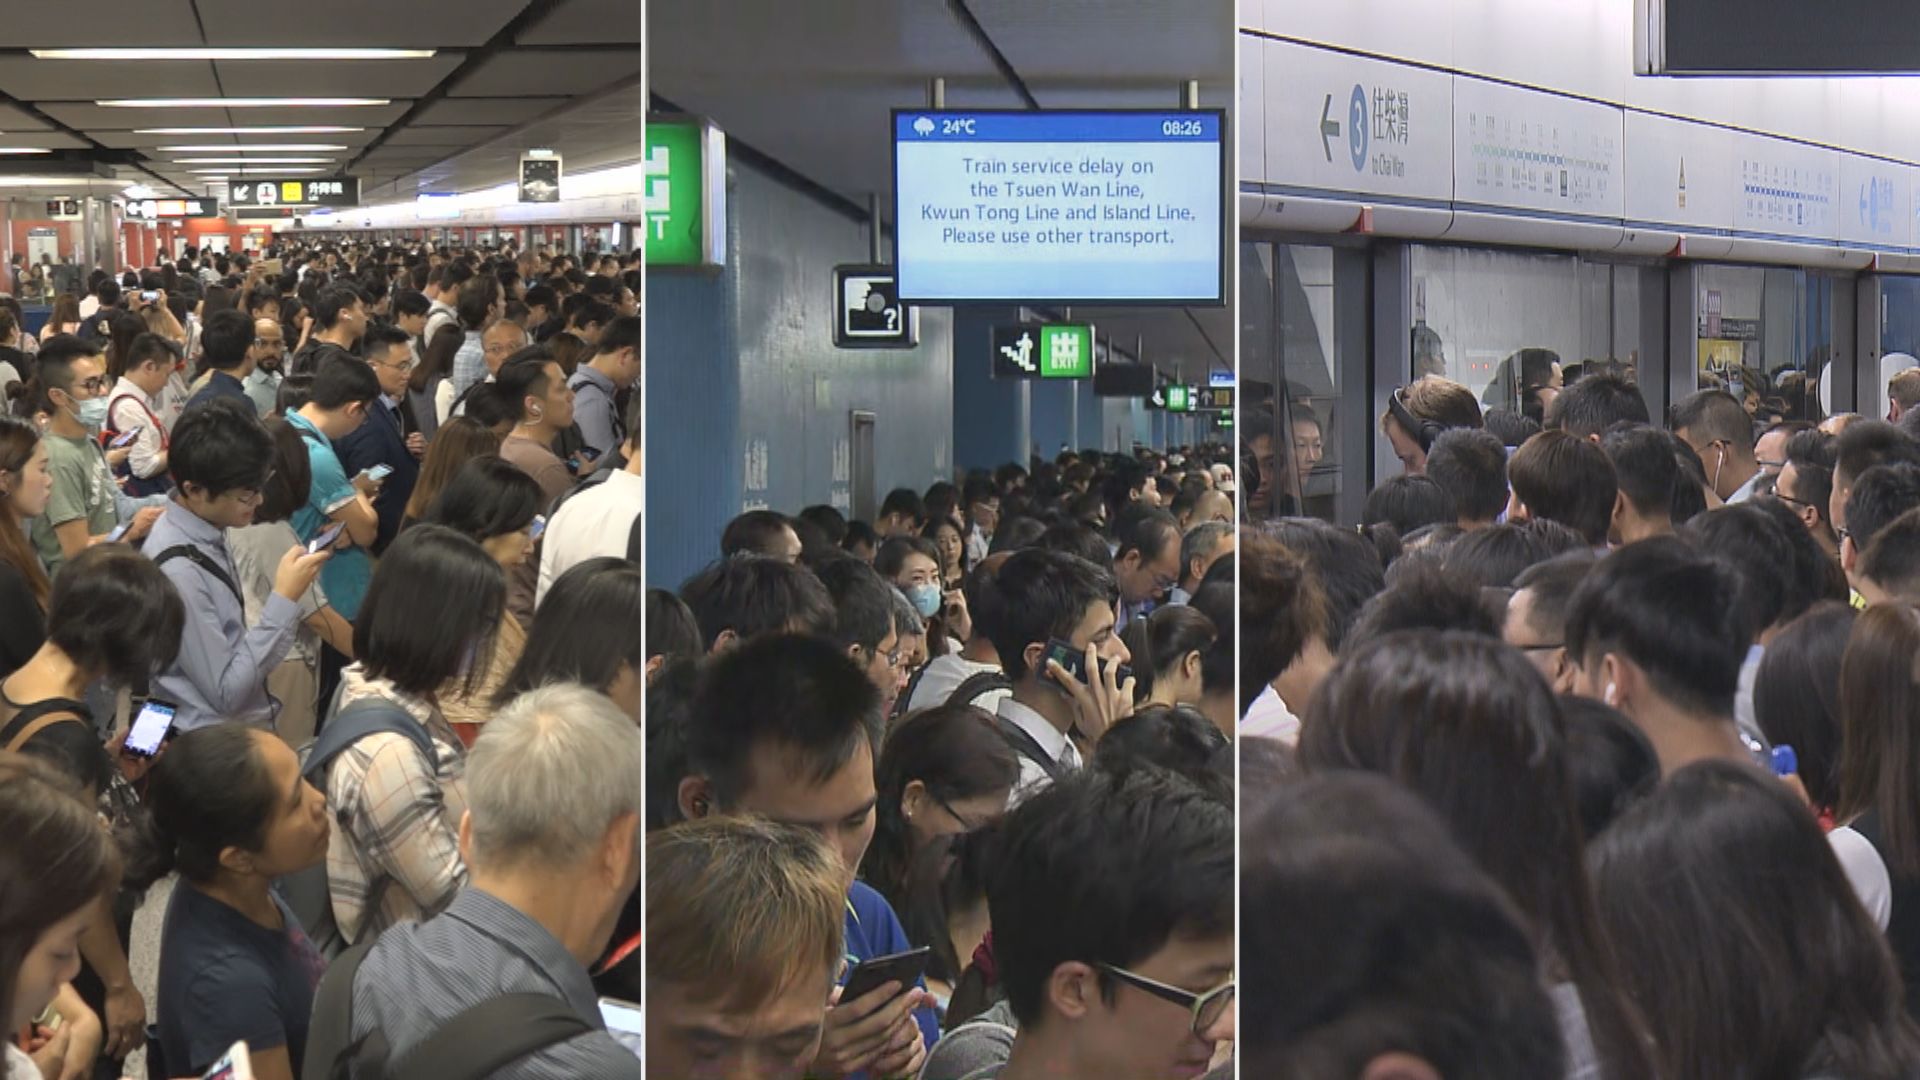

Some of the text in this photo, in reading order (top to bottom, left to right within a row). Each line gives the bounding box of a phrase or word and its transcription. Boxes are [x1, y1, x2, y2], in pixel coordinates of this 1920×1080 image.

[942, 118, 1202, 136] 24°C 08:26
[1354, 98, 1363, 156] 3
[962, 157, 1154, 178] Train service delay on
[970, 181, 1145, 200] the Tsuen Wan Line,
[921, 203, 1196, 225] Kwun Tong Line and Island Line.
[943, 227, 1174, 248] Please use other transport.
[1051, 357, 1079, 369] EXIT
